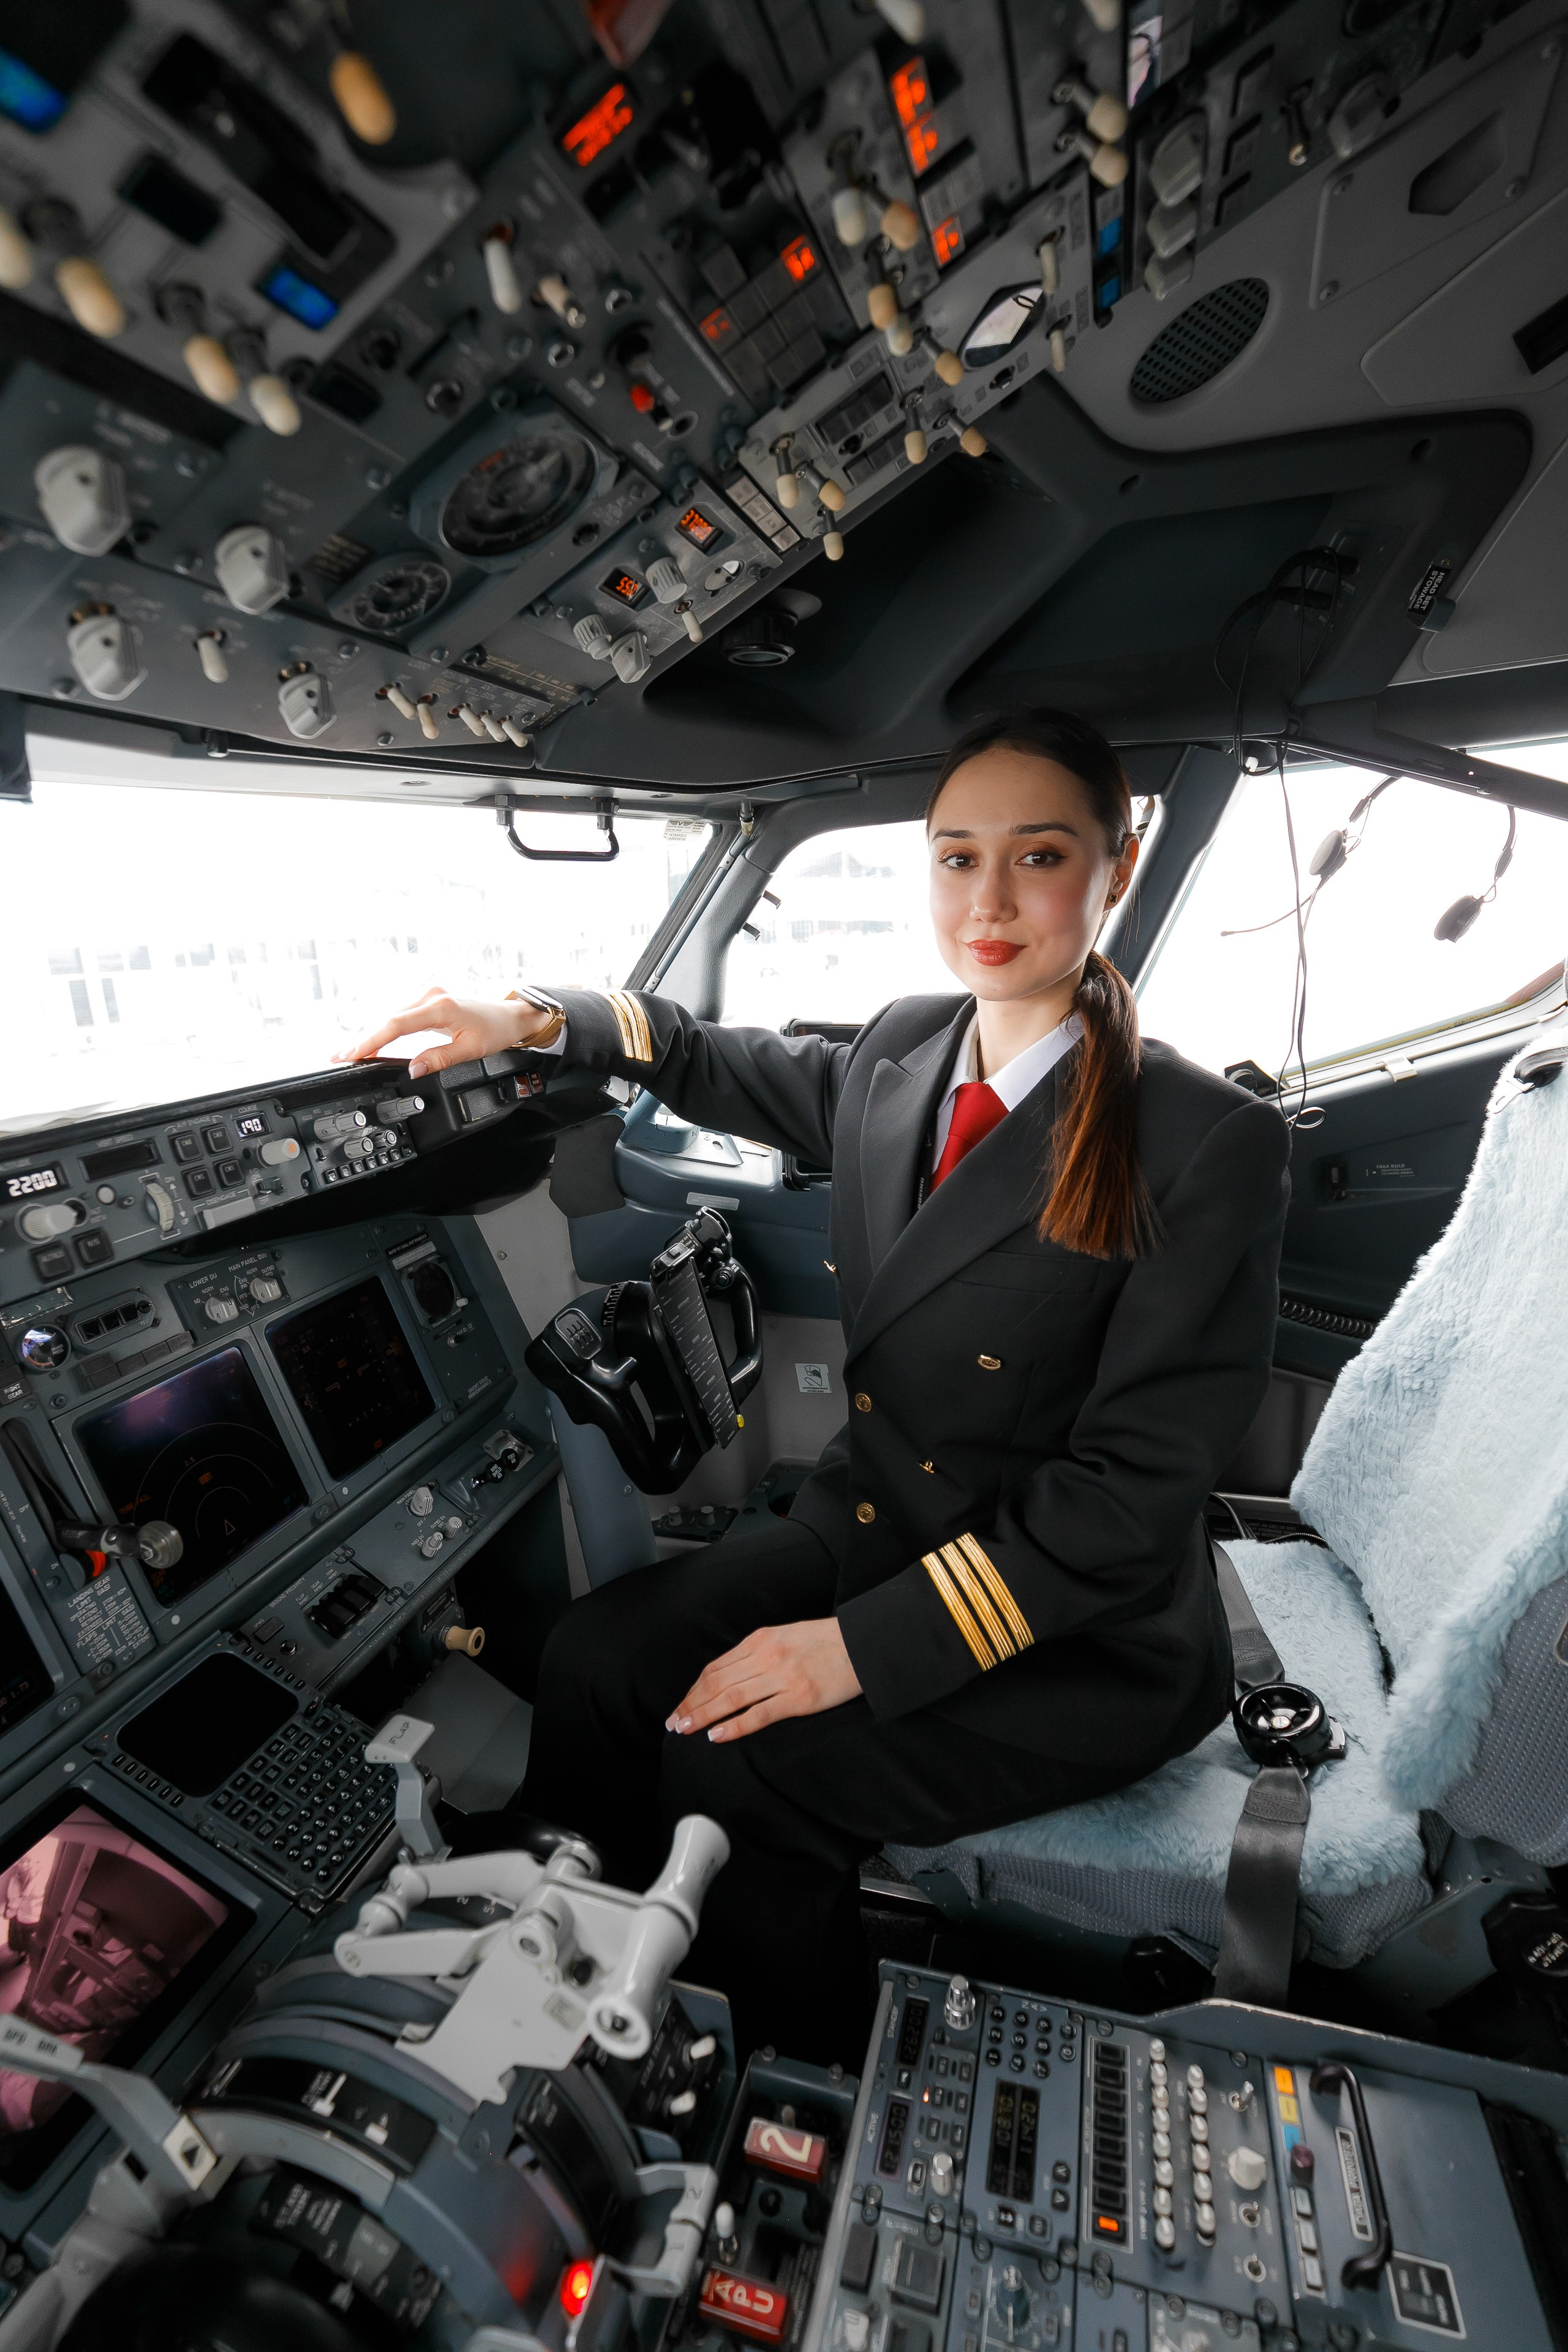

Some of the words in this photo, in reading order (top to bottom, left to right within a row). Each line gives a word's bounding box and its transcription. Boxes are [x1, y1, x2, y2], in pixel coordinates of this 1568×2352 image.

[1414, 570, 1438, 609] STOWAGE
[1430, 572, 1445, 594] HEAD
[1421, 595, 1431, 610] SET
[241, 1118, 263, 1134] 190
[6, 1170, 58, 1197] 2200
[206, 1191, 237, 1206] DISENGAGE
[228, 1263, 241, 1272] MAIN
[241, 1257, 257, 1267] PANEL
[189, 1276, 208, 1288] LOWER
[3, 1383, 21, 1394] RIGHT
[8, 1389, 23, 1400] GEAR
[467, 1382, 480, 1394] SHORT
[478, 1376, 488, 1386] FIELD
[468, 1379, 492, 1400] PERFORMANCE
[184, 1456, 195, 1467] 2.5
[397, 1496, 406, 1505] MAIN
[404, 1490, 416, 1498] PANEL
[19, 1504, 29, 1513] OFF
[68, 1588, 94, 1608] LANDING
[94, 1576, 110, 1589] GEAR
[270, 1593, 287, 1608] GROUND
[286, 1577, 306, 1596] PROXIMITY
[77, 1630, 97, 1648] FLAPS
[102, 1616, 116, 1630] LIMIT
[132, 1634, 150, 1649] EXTEND
[388, 1721, 410, 1744] FLAP
[888, 2005, 899, 2039] STANDBY
[867, 2113, 878, 2143] ACTIVE
[760, 2127, 813, 2163] 2
[714, 2279, 775, 2315] APU
